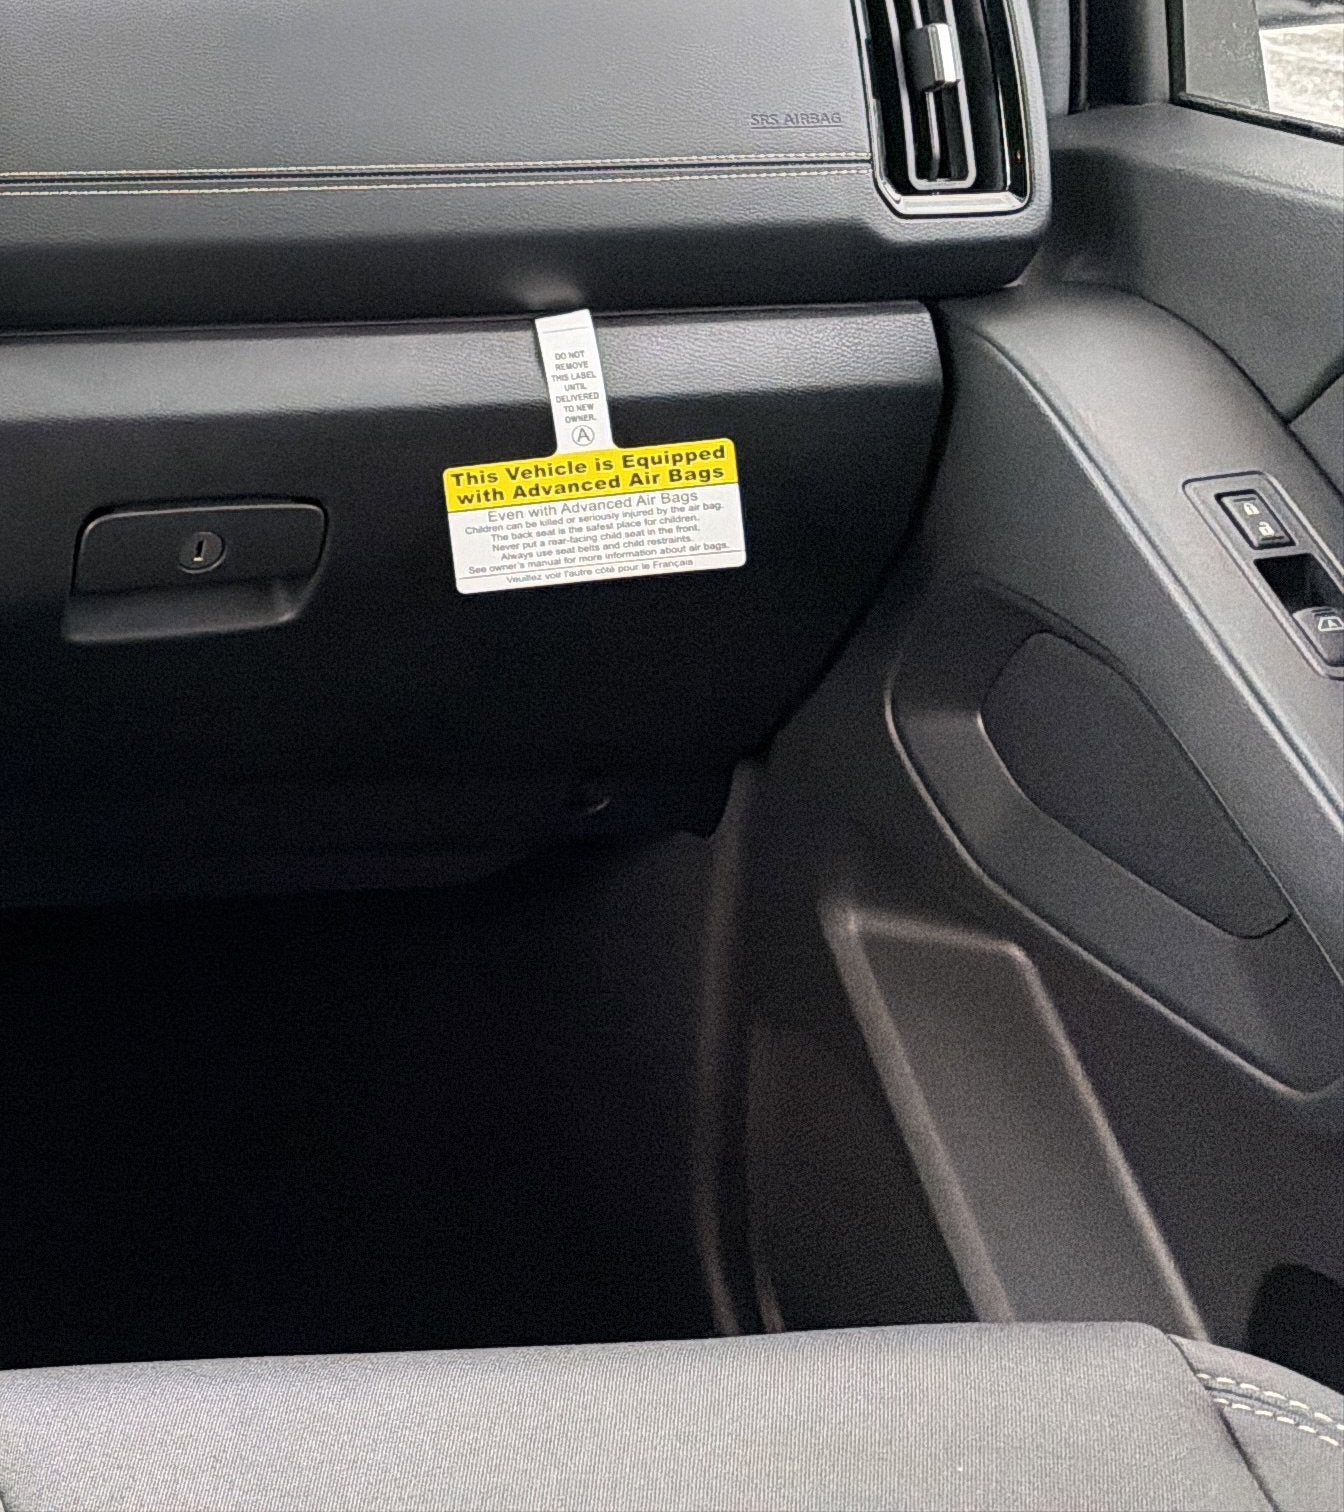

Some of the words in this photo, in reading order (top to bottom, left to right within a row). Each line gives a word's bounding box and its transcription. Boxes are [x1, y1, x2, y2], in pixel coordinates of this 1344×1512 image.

[750, 112, 780, 126] SRS
[784, 111, 842, 126] AIRBAG
[555, 352, 567, 361] DO
[568, 350, 585, 359] NOT
[555, 361, 589, 371] REMOVE
[551, 374, 569, 382] THIS
[571, 371, 597, 380] LABEL
[564, 383, 587, 391] UNTIL
[556, 392, 599, 403] DELIVERED
[563, 405, 574, 413] TO
[576, 403, 594, 412] NEW
[577, 427, 592, 443] A
[452, 470, 498, 487] This
[505, 461, 587, 481] Vehicle
[595, 457, 614, 471] is
[622, 445, 725, 468] Equipped
[456, 488, 504, 504] with
[513, 475, 620, 499] Advanced
[629, 472, 660, 487] Air
[668, 467, 724, 483] Bags
[488, 510, 524, 522] Even
[528, 505, 557, 517] with
[561, 497, 632, 515] Advanced
[636, 494, 656, 506] Air
[661, 491, 699, 505] Bags
[465, 524, 504, 535] Children
[525, 520, 537, 528] be
[539, 517, 563, 526] killed
[578, 512, 619, 523] seriously
[622, 508, 653, 519] injured
[656, 507, 667, 516] by
[670, 505, 686, 513] the
[688, 503, 700, 511] air
